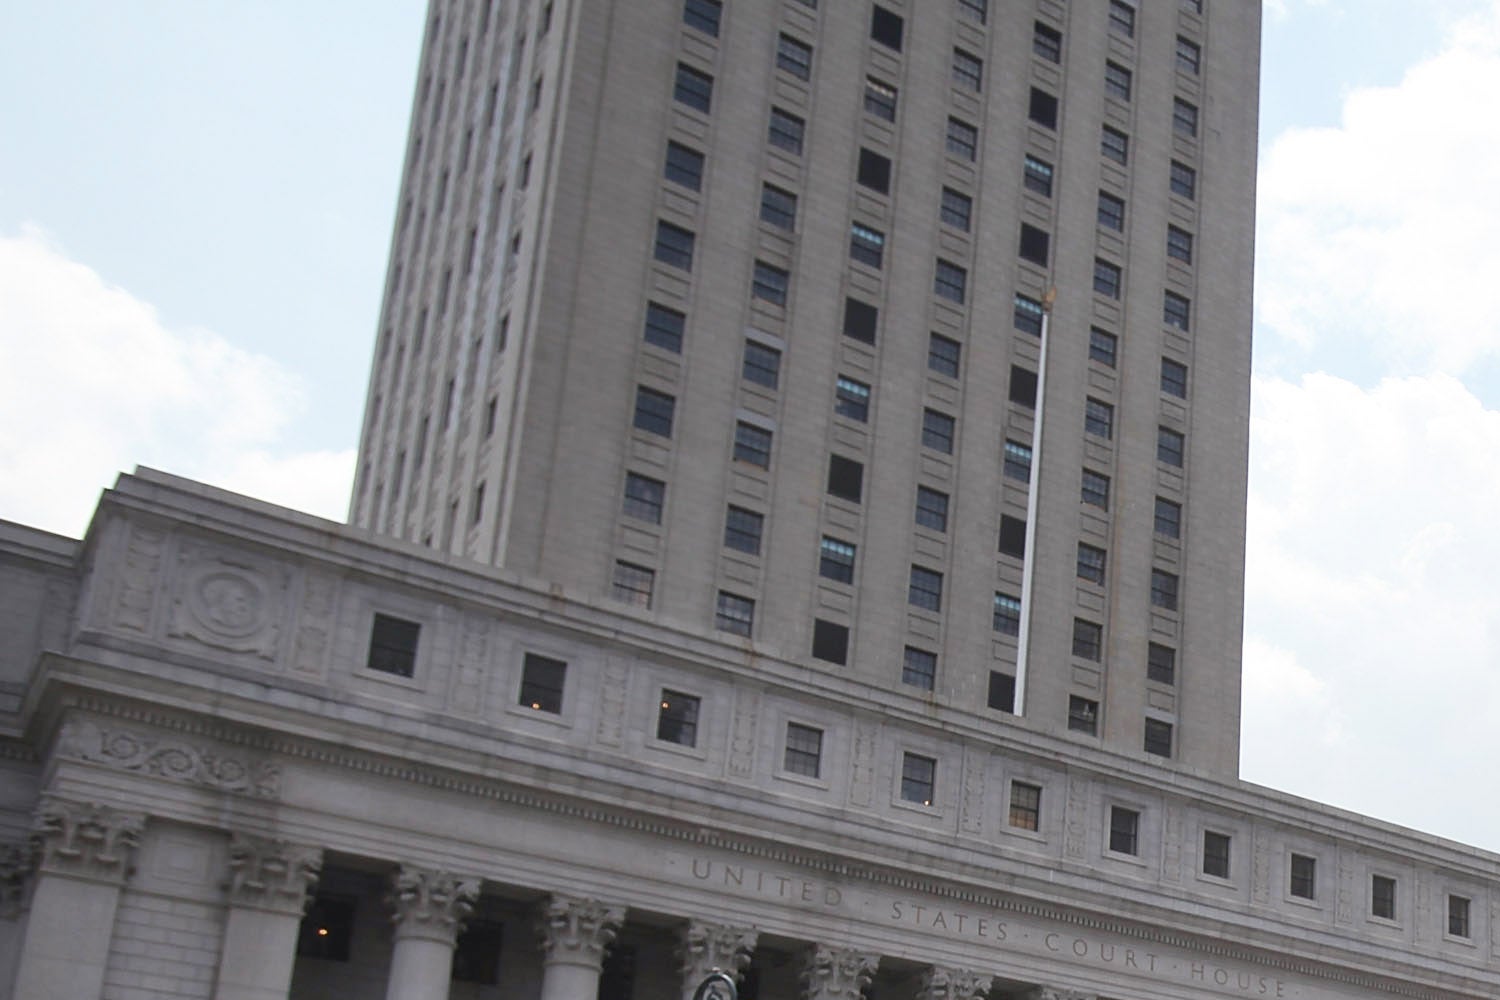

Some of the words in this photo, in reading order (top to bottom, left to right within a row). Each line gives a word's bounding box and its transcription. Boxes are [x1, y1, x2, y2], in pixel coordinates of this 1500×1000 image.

[691, 858, 843, 906] UNITED
[891, 902, 1008, 942] STATES
[1045, 933, 1157, 972] COURT
[1191, 963, 1287, 998] HOUSE
